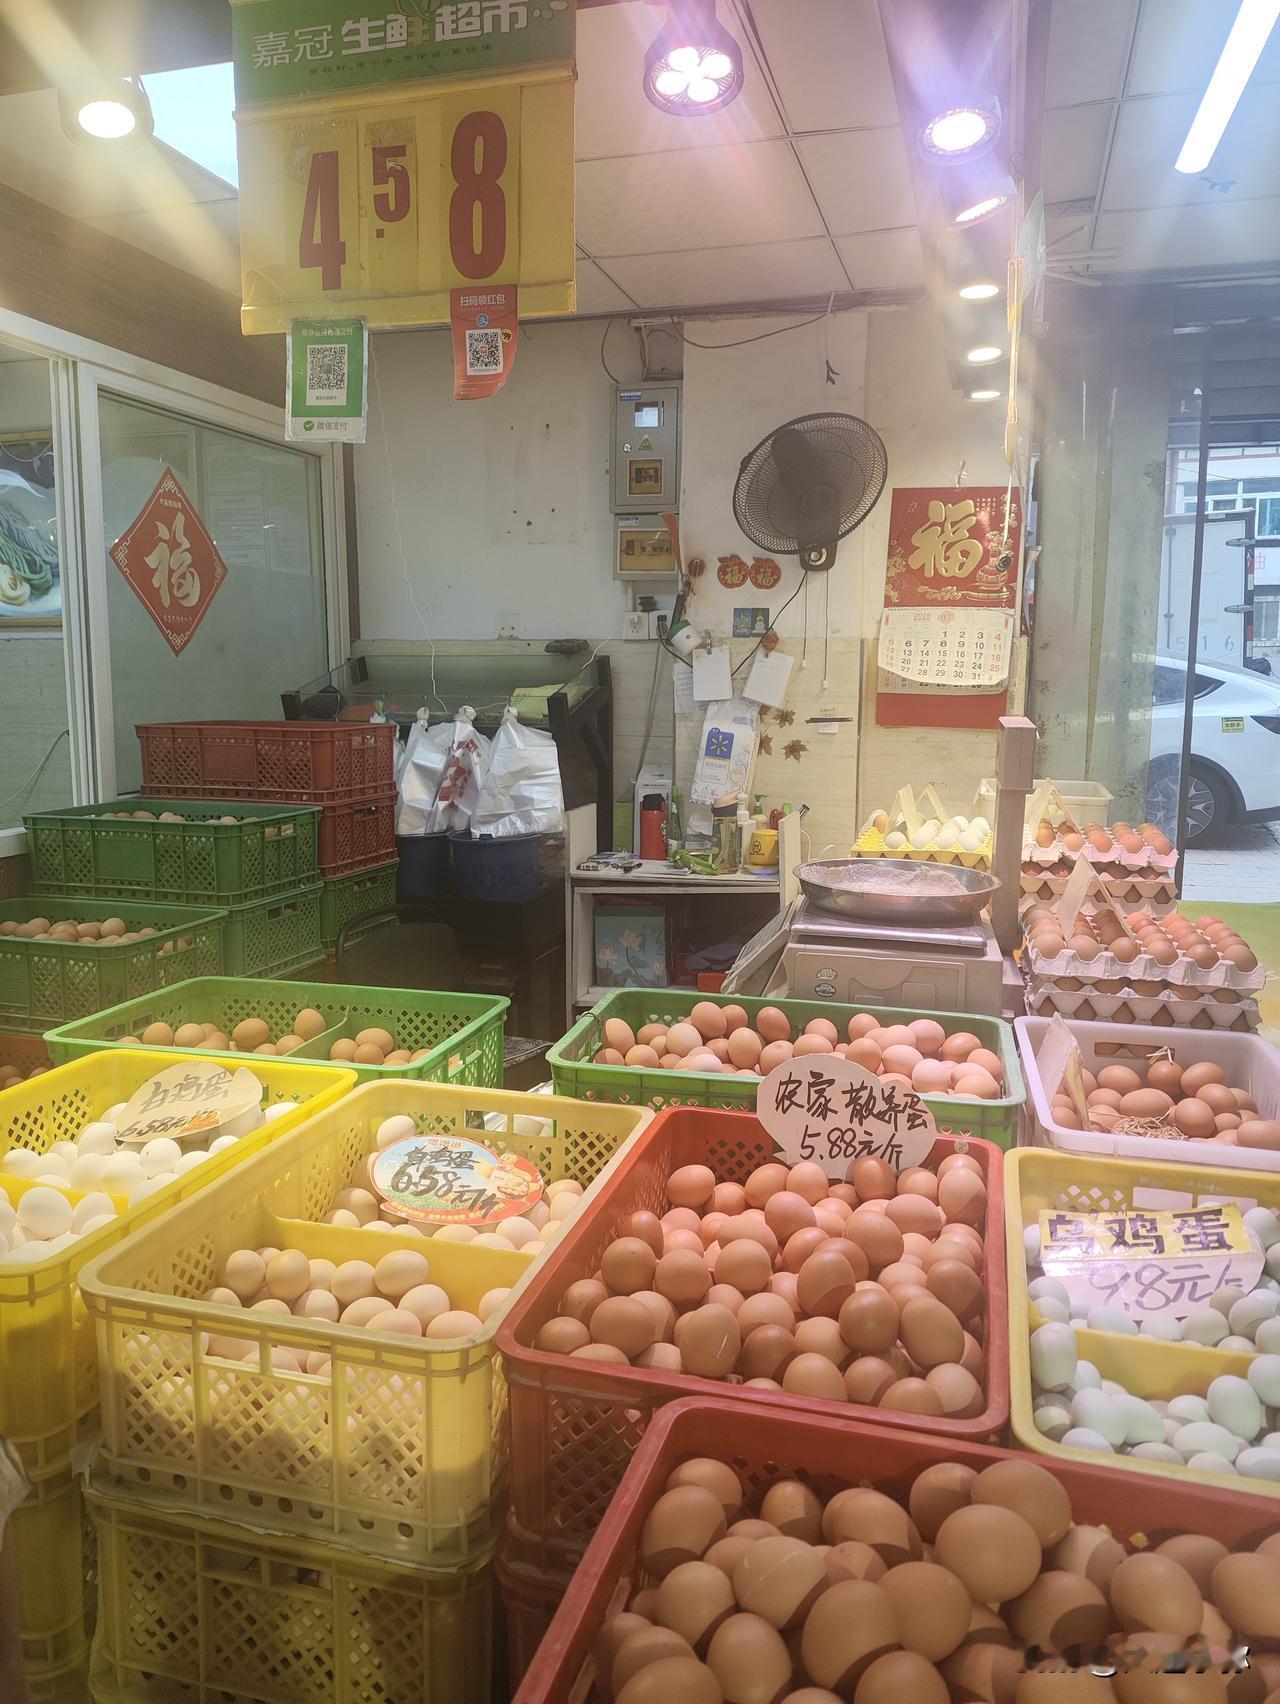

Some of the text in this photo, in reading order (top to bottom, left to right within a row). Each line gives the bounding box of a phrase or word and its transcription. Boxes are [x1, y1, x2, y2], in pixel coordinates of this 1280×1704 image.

[316, 422, 347, 431] 微信支付
[907, 500, 983, 578] 福
[144, 511, 201, 608] 福
[977, 631, 984, 639] 3
[994, 633, 1002, 641] 4
[958, 640, 965, 648] 9
[974, 642, 984, 650] 10
[956, 650, 965, 658] 16
[971, 662, 982, 670] 24
[990, 664, 1000, 672] 25
[971, 672, 981, 680] 31
[1043, 1208, 1235, 1255] 乌鸡蛋
